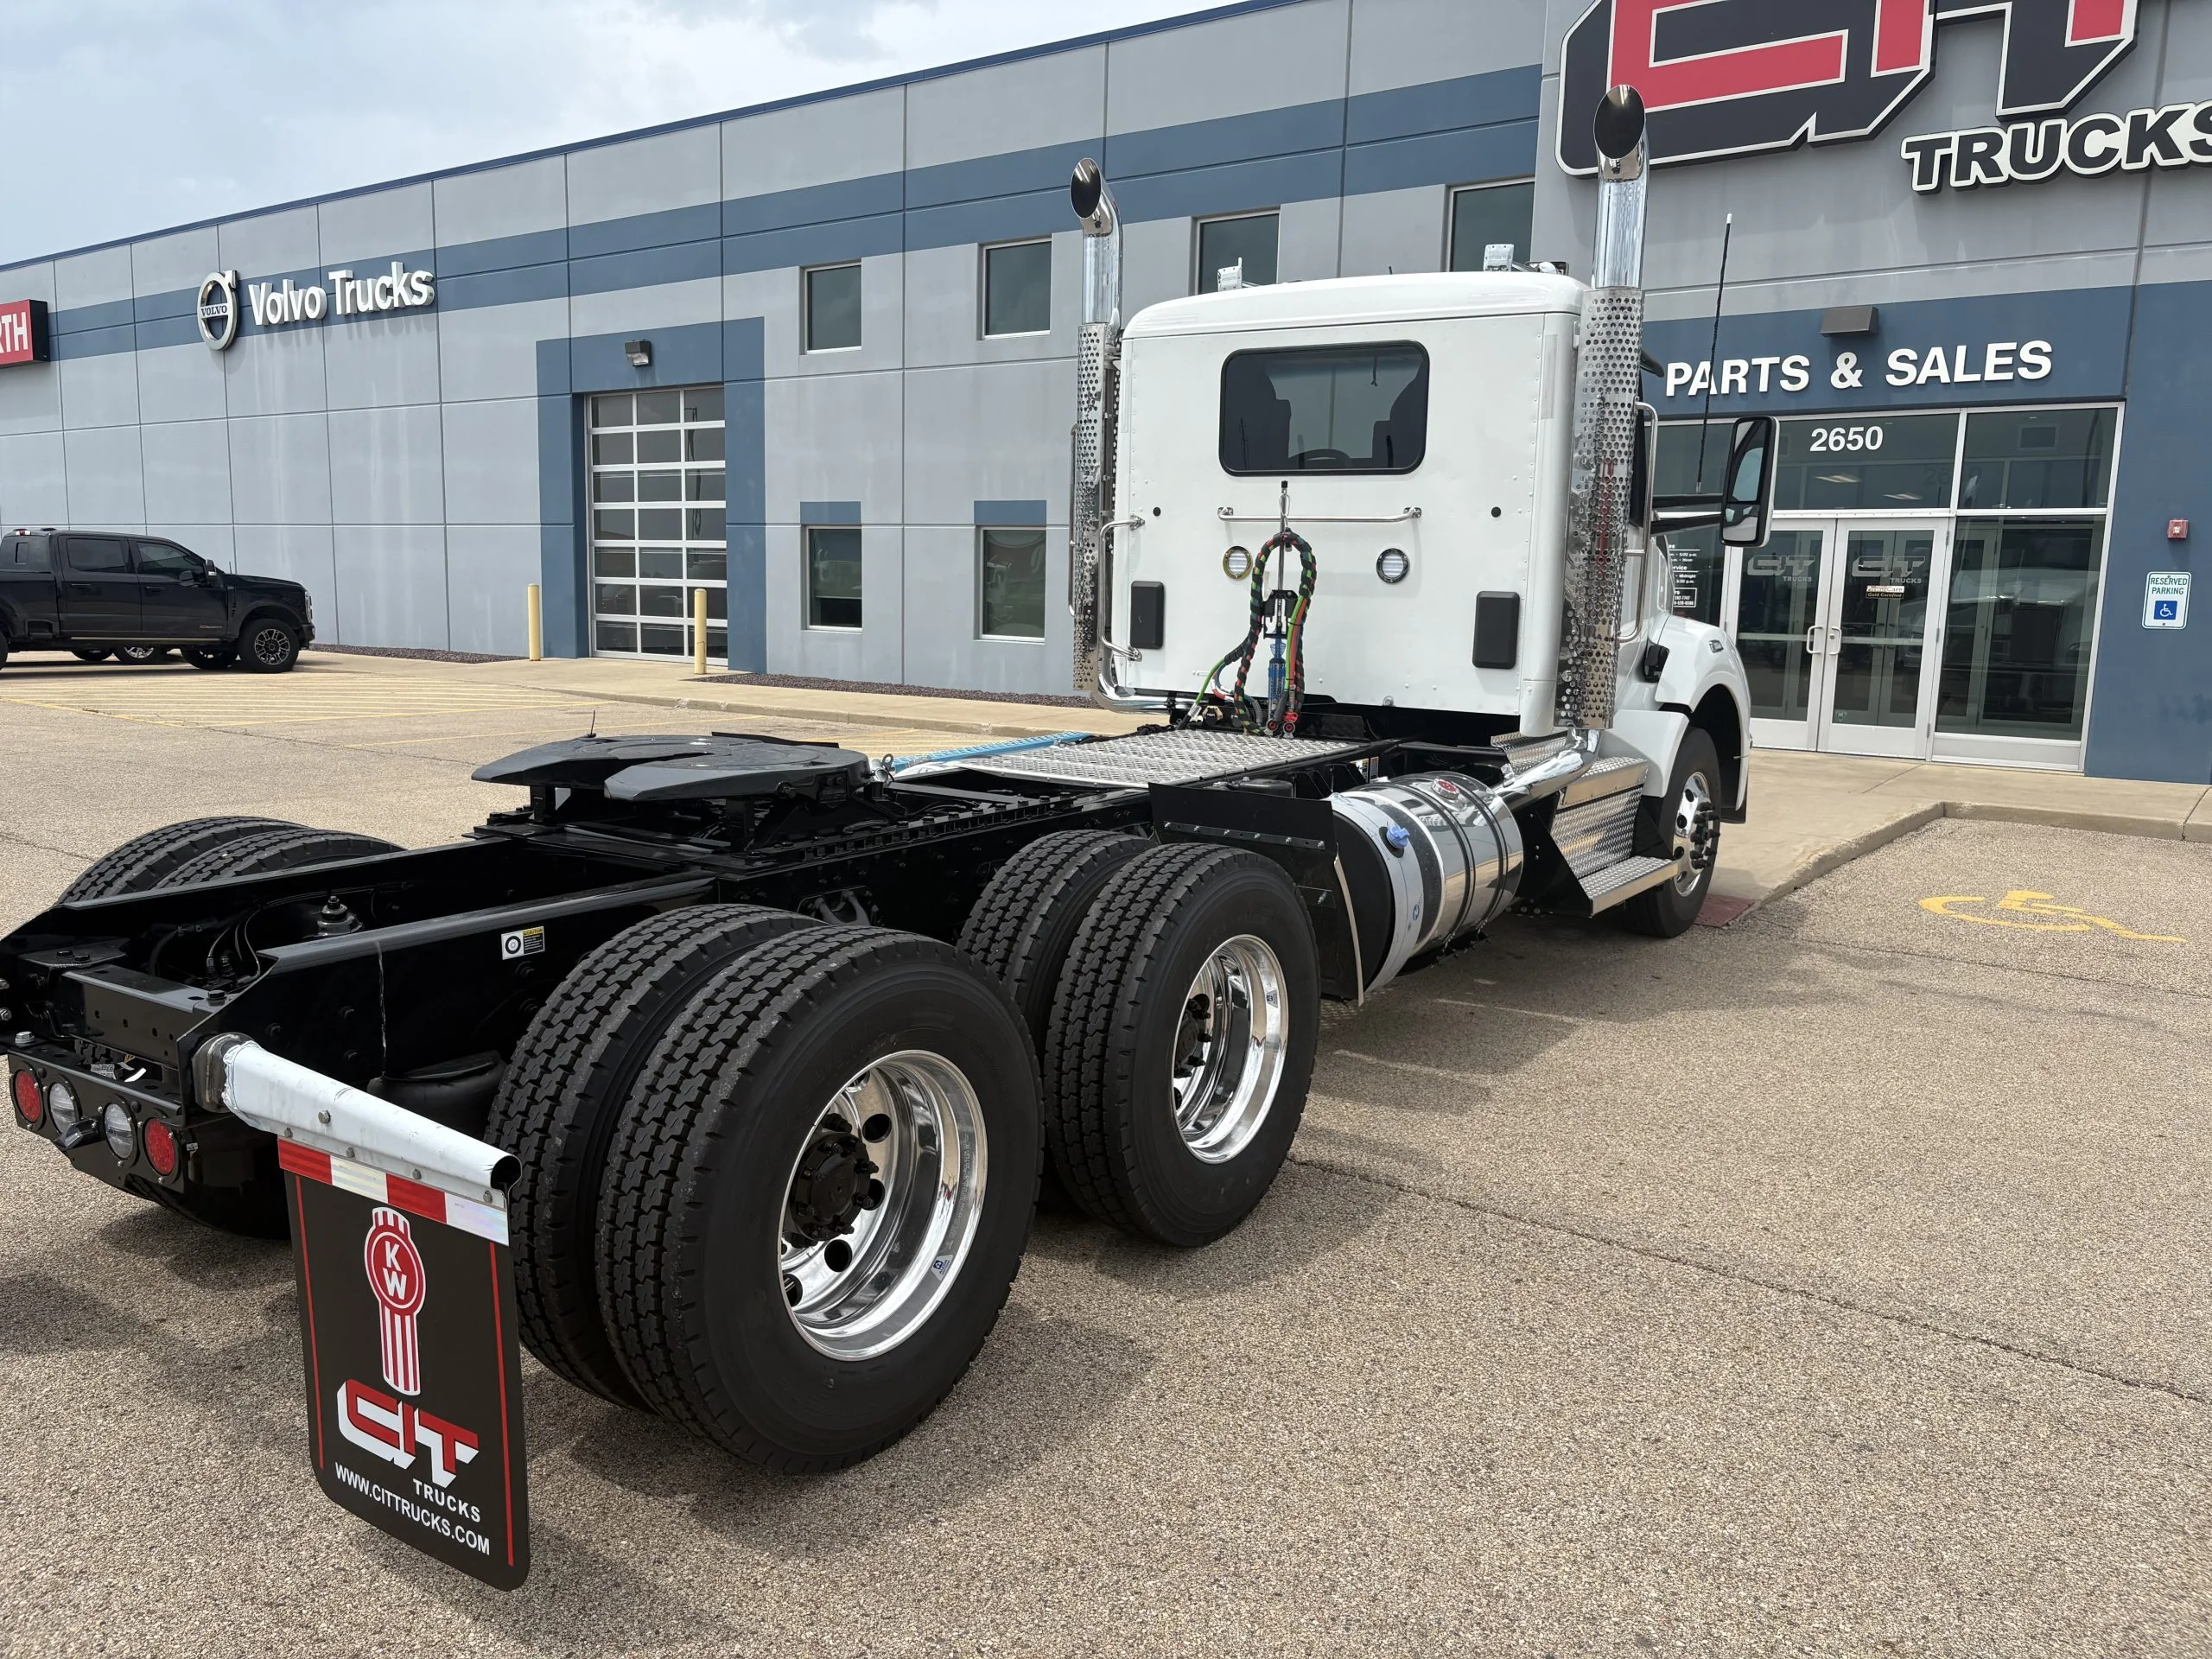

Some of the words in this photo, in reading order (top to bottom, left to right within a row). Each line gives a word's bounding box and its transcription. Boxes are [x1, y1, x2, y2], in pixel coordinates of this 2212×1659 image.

[201, 305, 227, 316] VOLVO
[248, 279, 327, 326] Volvo
[328, 261, 434, 315] Trucks
[1667, 354, 1809, 397] PARTS
[1831, 353, 1863, 389] &
[1887, 341, 2052, 385] SALES
[1810, 426, 1883, 452] 2650
[385, 1241, 400, 1272] K
[383, 1267, 407, 1300] W
[336, 1378, 479, 1488] CIT
[334, 1461, 490, 1555] WWW.CITTRUCKS.COM
[413, 1478, 481, 1523] TRUCKS
